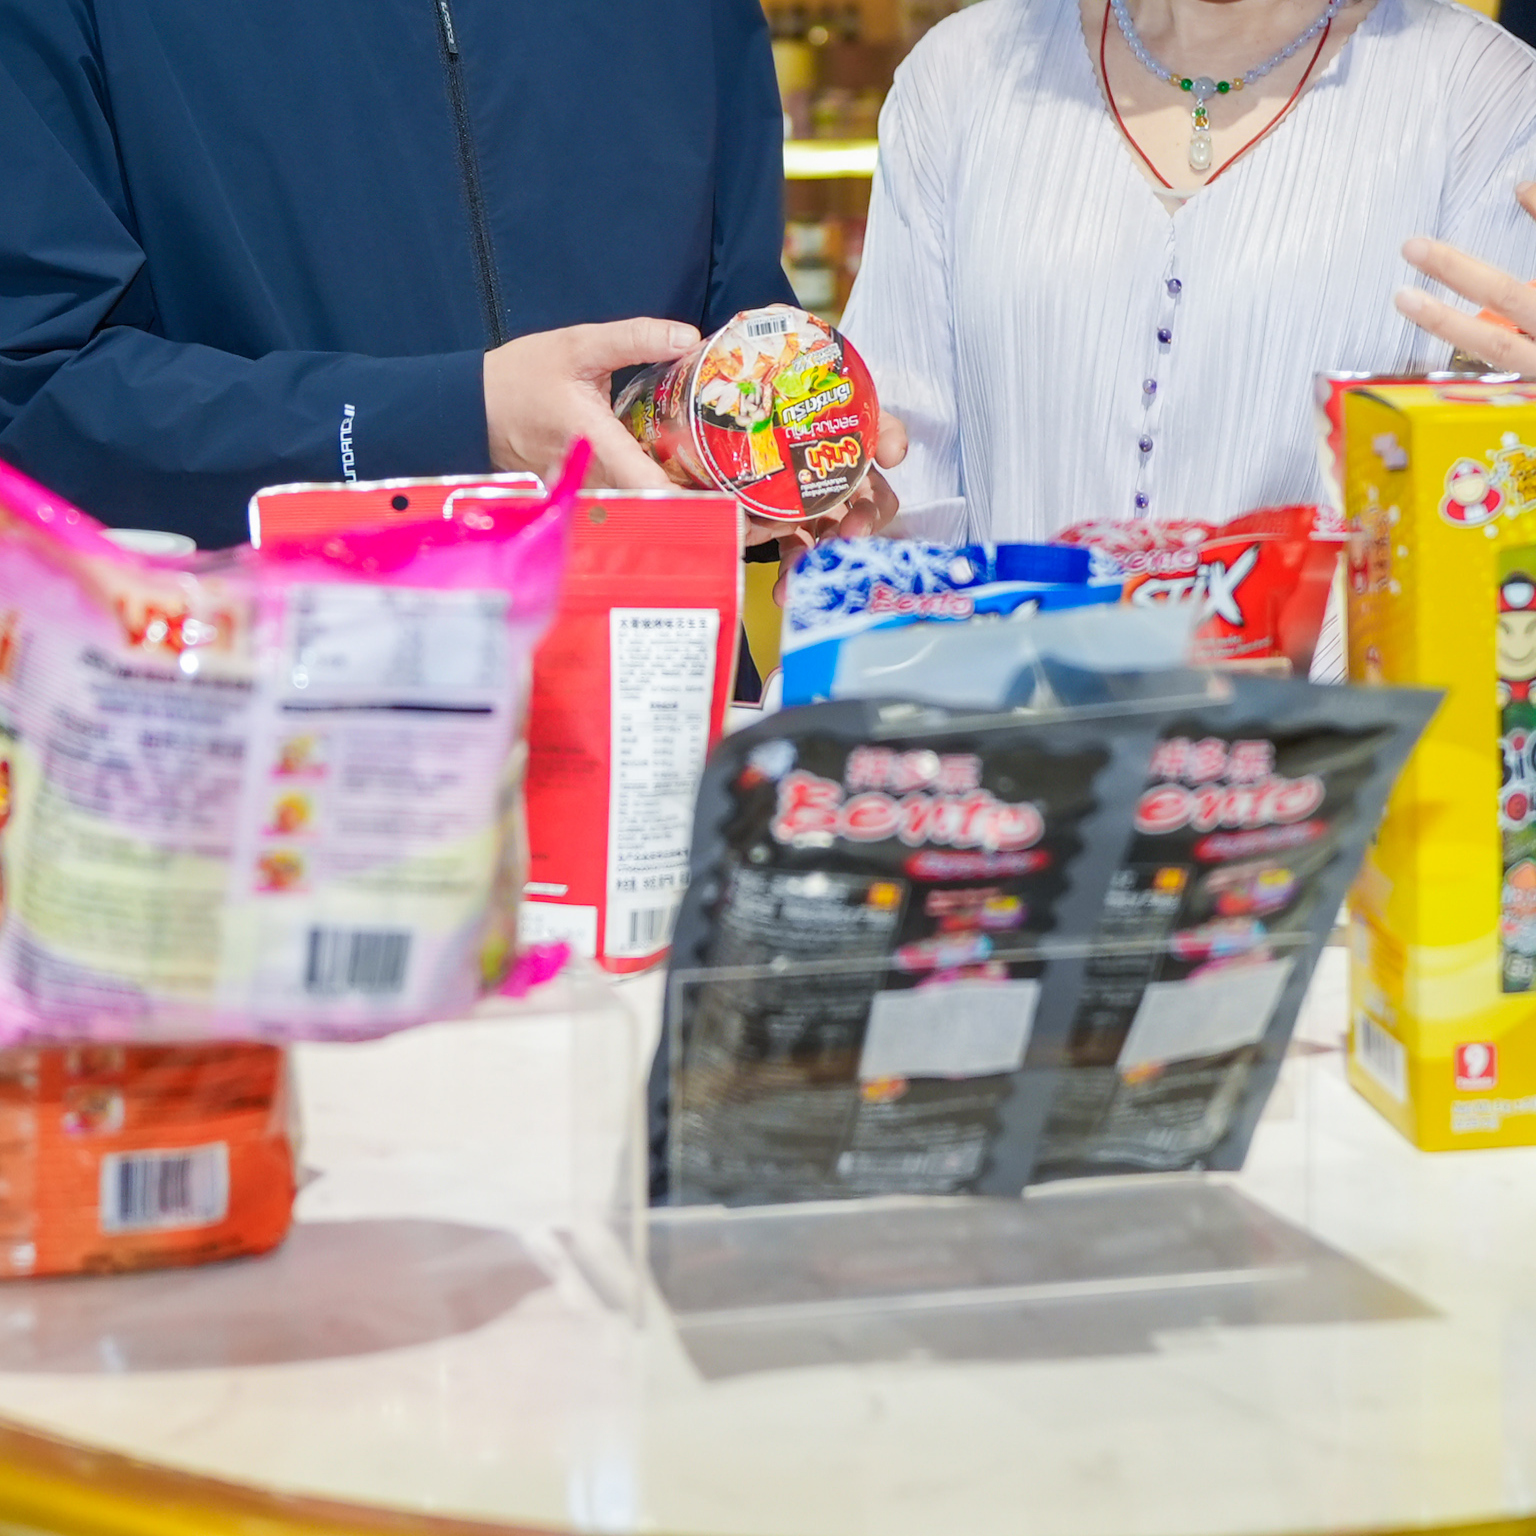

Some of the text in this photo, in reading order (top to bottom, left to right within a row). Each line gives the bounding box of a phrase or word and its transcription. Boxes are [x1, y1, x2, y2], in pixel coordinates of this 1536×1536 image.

[340, 415, 357, 483] UNDANC
[806, 437, 860, 479] มาม่า
[1122, 545, 1201, 574] ento
[869, 584, 974, 620] Bento
[772, 770, 1045, 851] Bento
[1134, 775, 1325, 835] ento
